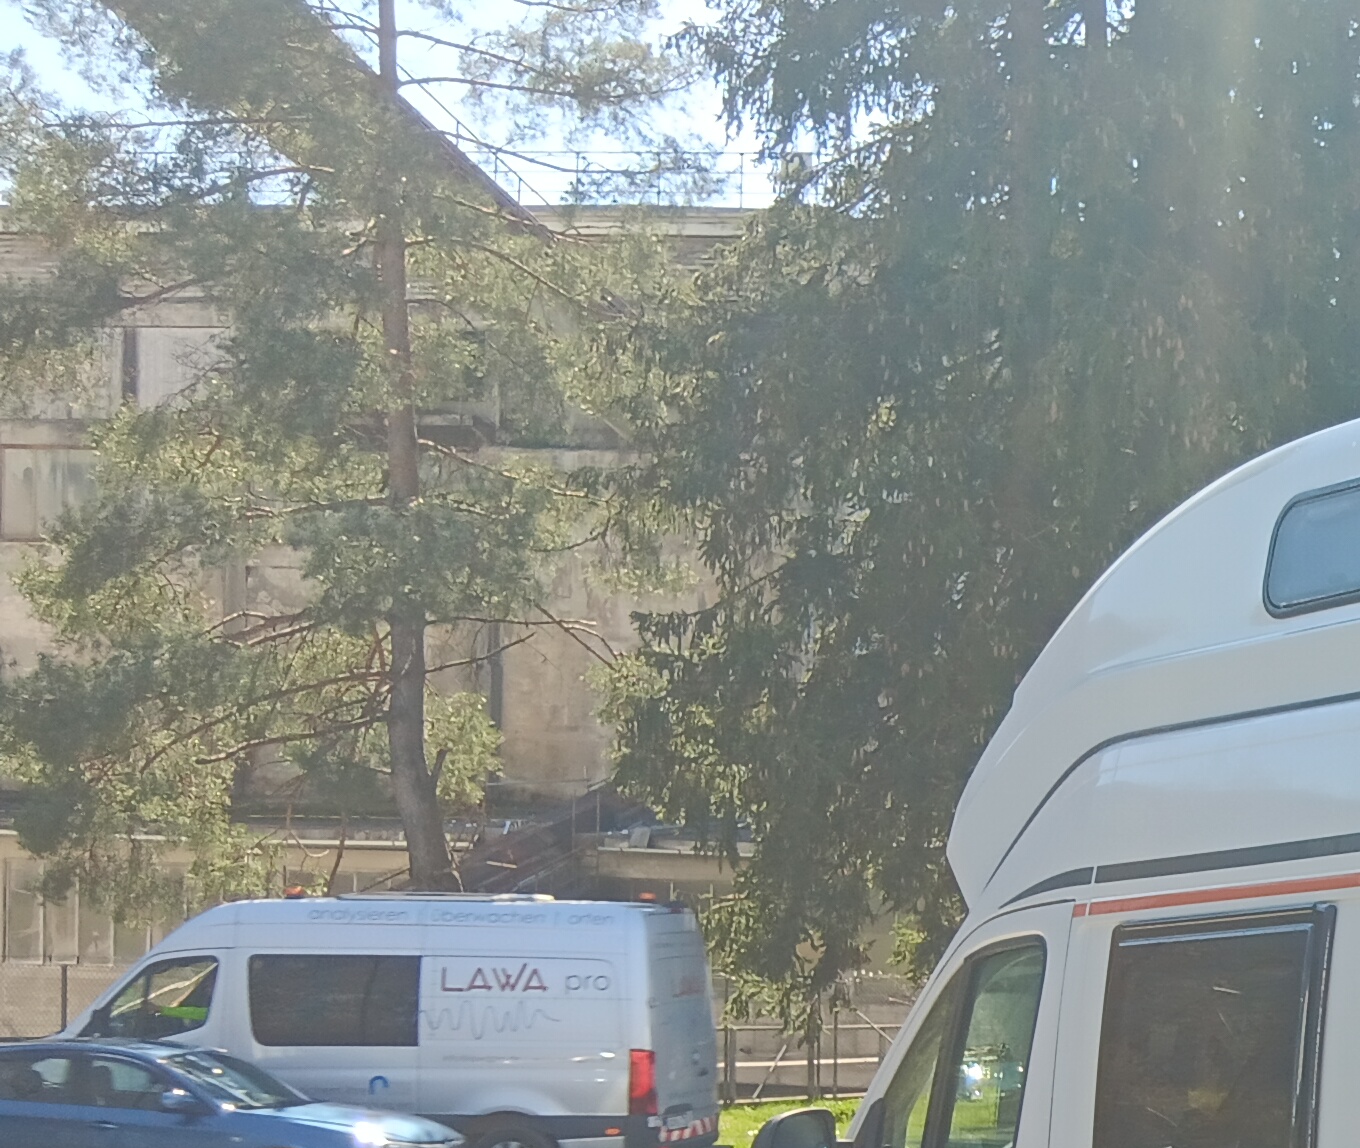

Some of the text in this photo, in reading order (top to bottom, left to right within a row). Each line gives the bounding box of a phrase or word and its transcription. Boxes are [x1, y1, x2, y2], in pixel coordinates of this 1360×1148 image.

[307, 906, 409, 925] analysieren
[440, 963, 611, 996] LAWA pro
